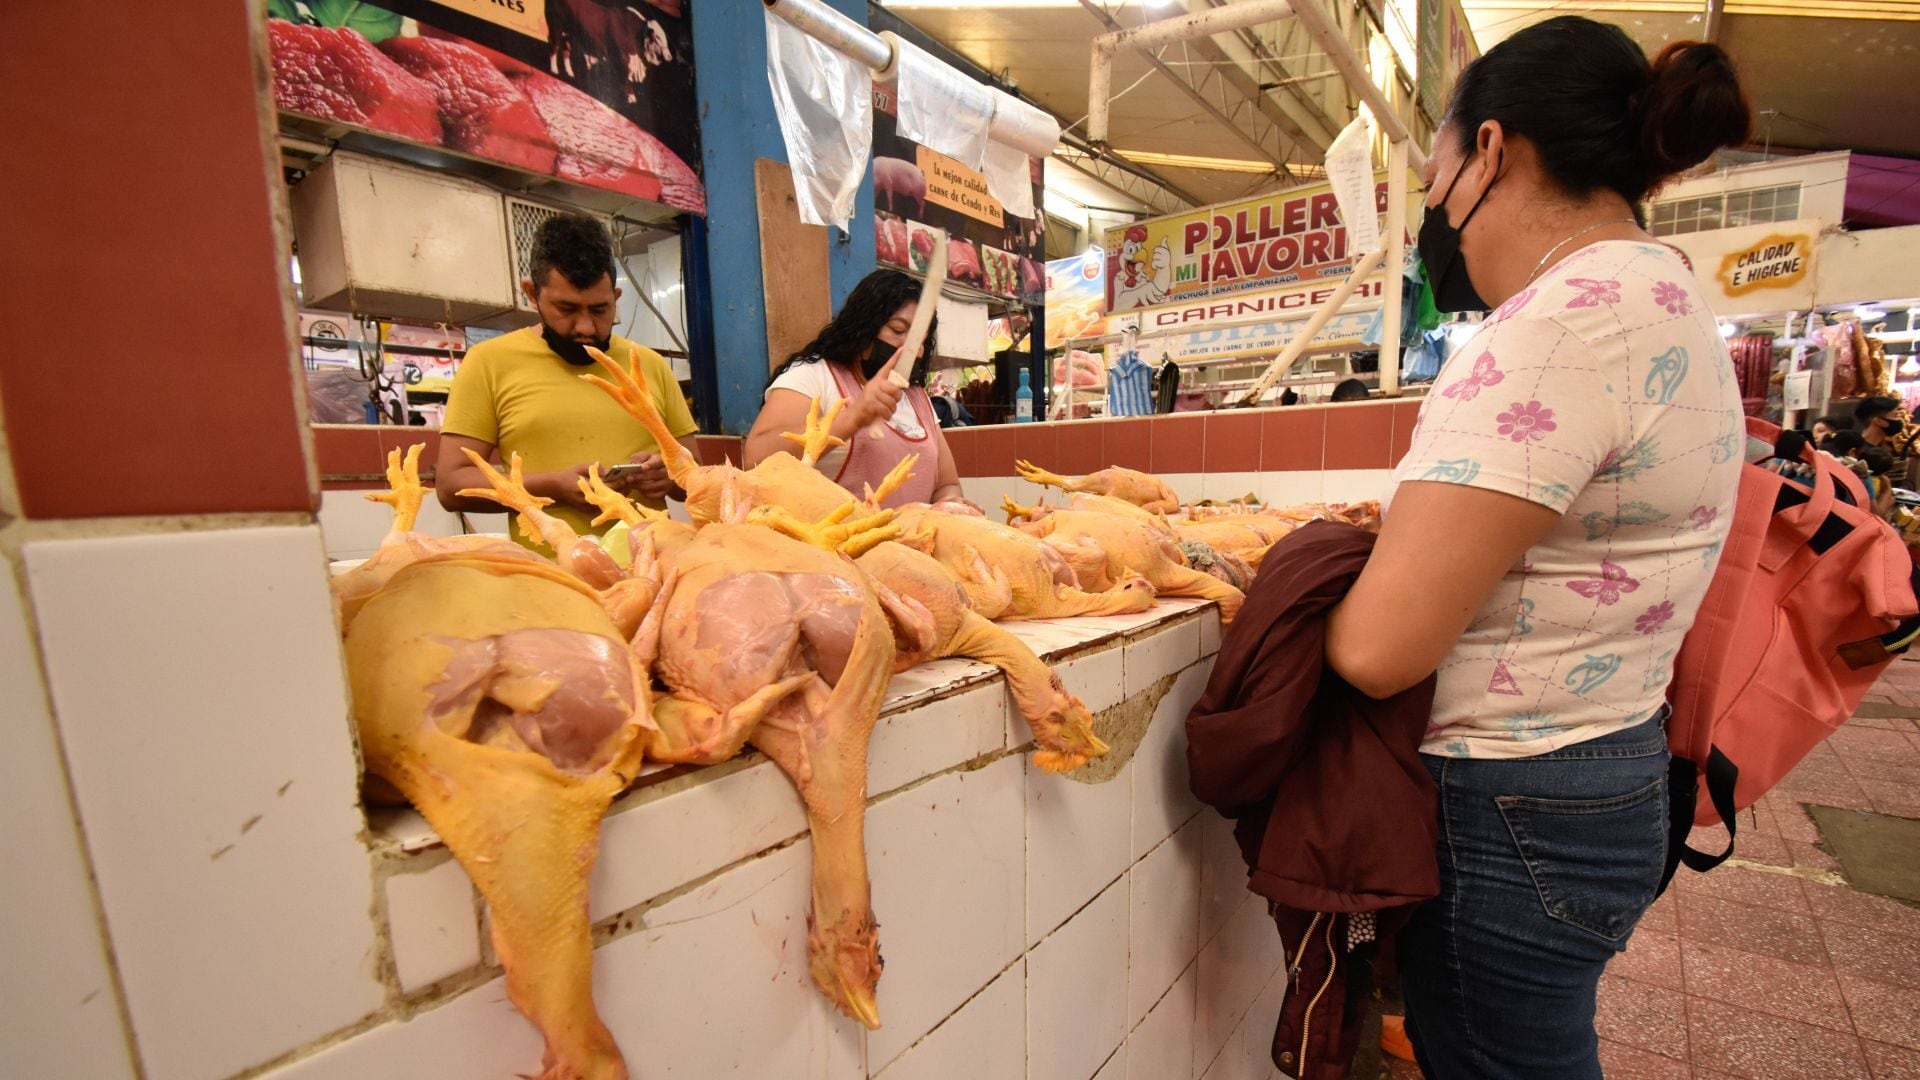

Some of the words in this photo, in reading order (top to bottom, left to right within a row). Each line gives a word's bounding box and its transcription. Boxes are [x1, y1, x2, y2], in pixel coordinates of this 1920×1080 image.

[1184, 182, 1388, 255] POLLERA
[1737, 242, 1795, 268] CALIDAD
[1176, 262, 1197, 282] MI
[1323, 265, 1352, 276] PIERN
[1733, 271, 1742, 287] E
[1747, 257, 1800, 282] HIGIENE
[1174, 288, 1209, 301] PECHUGA
[1241, 274, 1299, 290] EMPANIZADA
[1156, 282, 1382, 326] CARNICERI
[1190, 347, 1209, 355] MEJOR
[1224, 344, 1242, 352] CARNE
[1247, 342, 1254, 350] DE
[1257, 340, 1275, 348] CERDO
